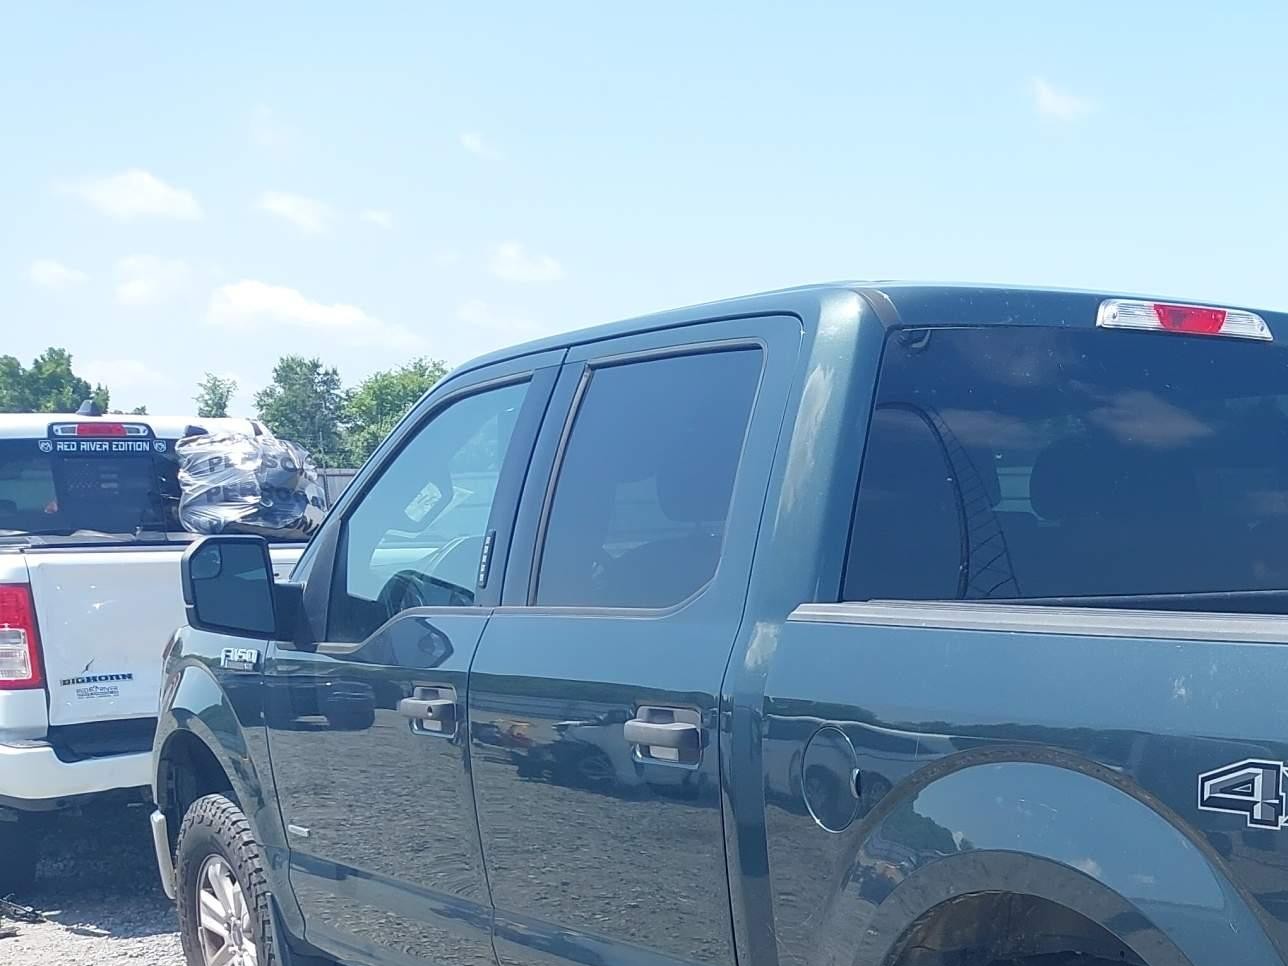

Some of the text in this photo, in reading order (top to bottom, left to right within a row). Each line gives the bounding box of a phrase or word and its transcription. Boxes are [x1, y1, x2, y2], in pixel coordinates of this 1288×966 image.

[56, 441, 150, 452] RED RIVER EDITION
